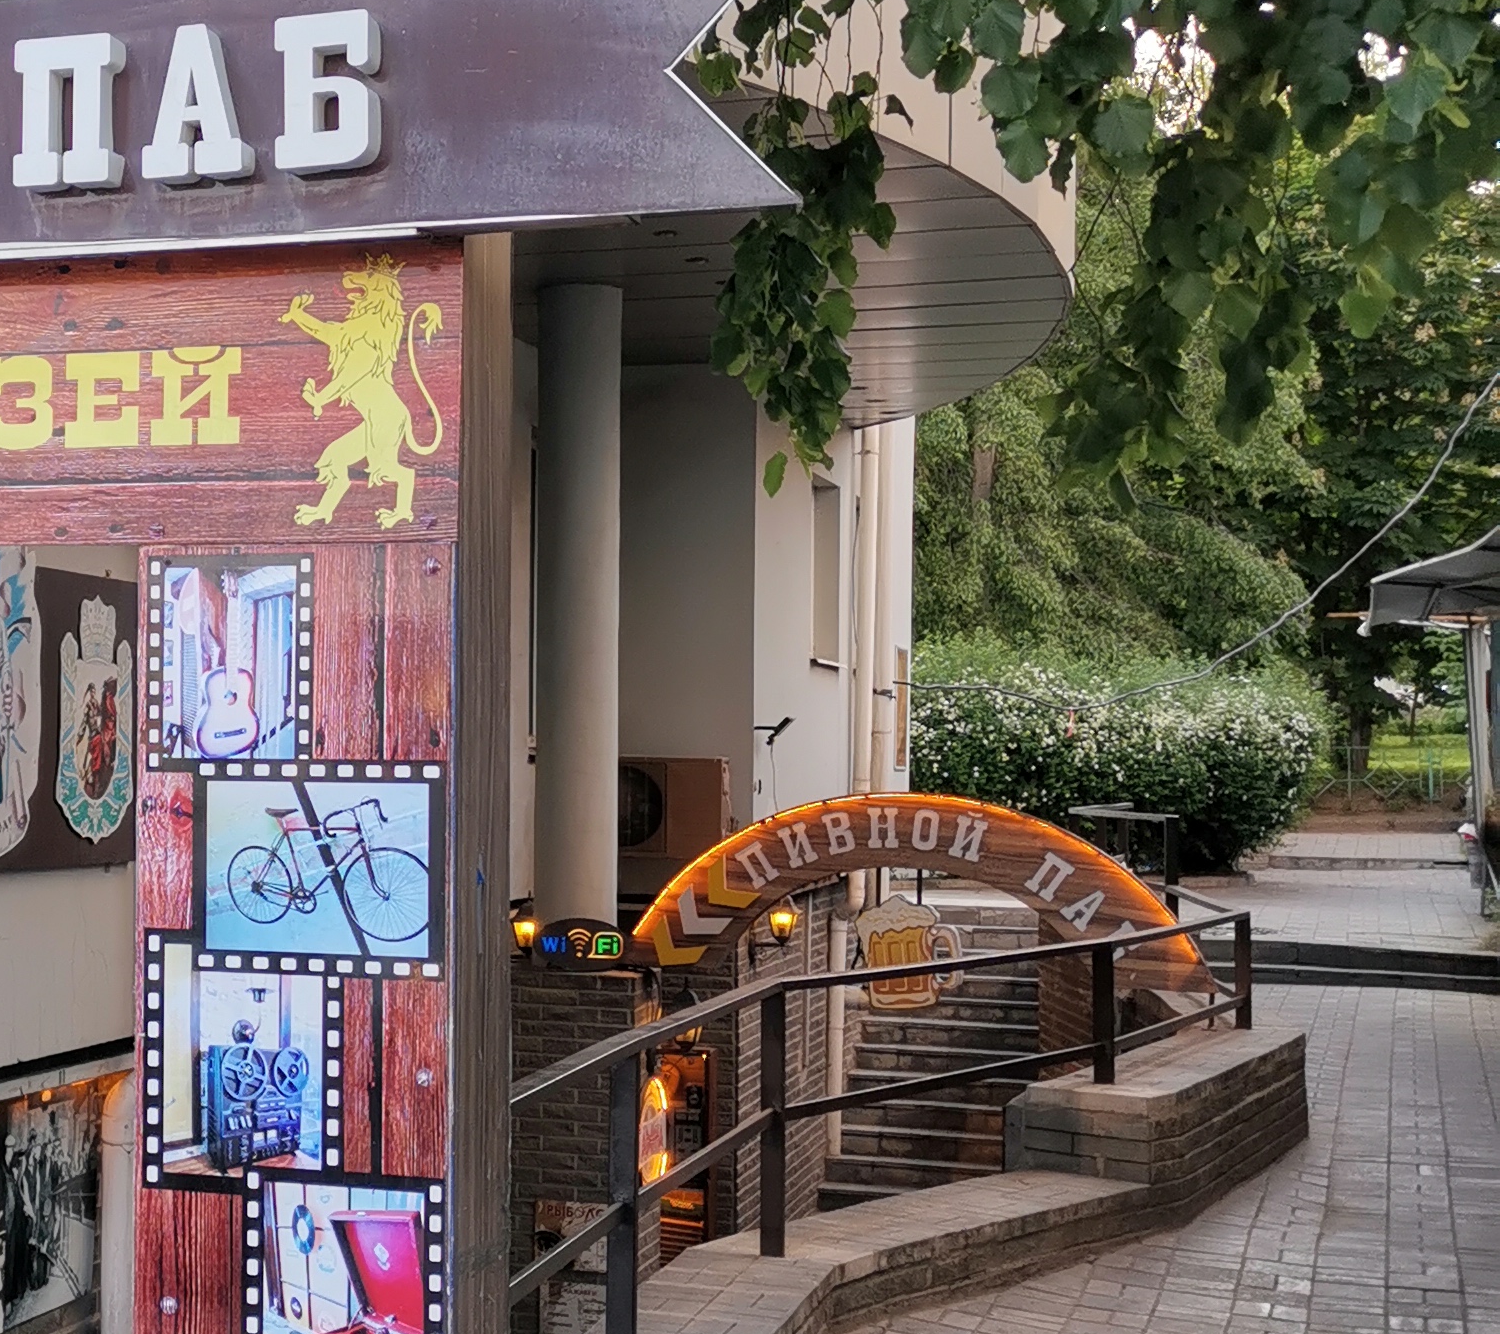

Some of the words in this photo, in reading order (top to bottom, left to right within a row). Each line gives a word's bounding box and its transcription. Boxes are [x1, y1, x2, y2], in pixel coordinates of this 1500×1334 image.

[13, 9, 382, 192] ПАБ
[735, 807, 988, 890] ПИВНОЙ
[541, 936, 566, 953] Wi
[597, 937, 618, 954] Fi
